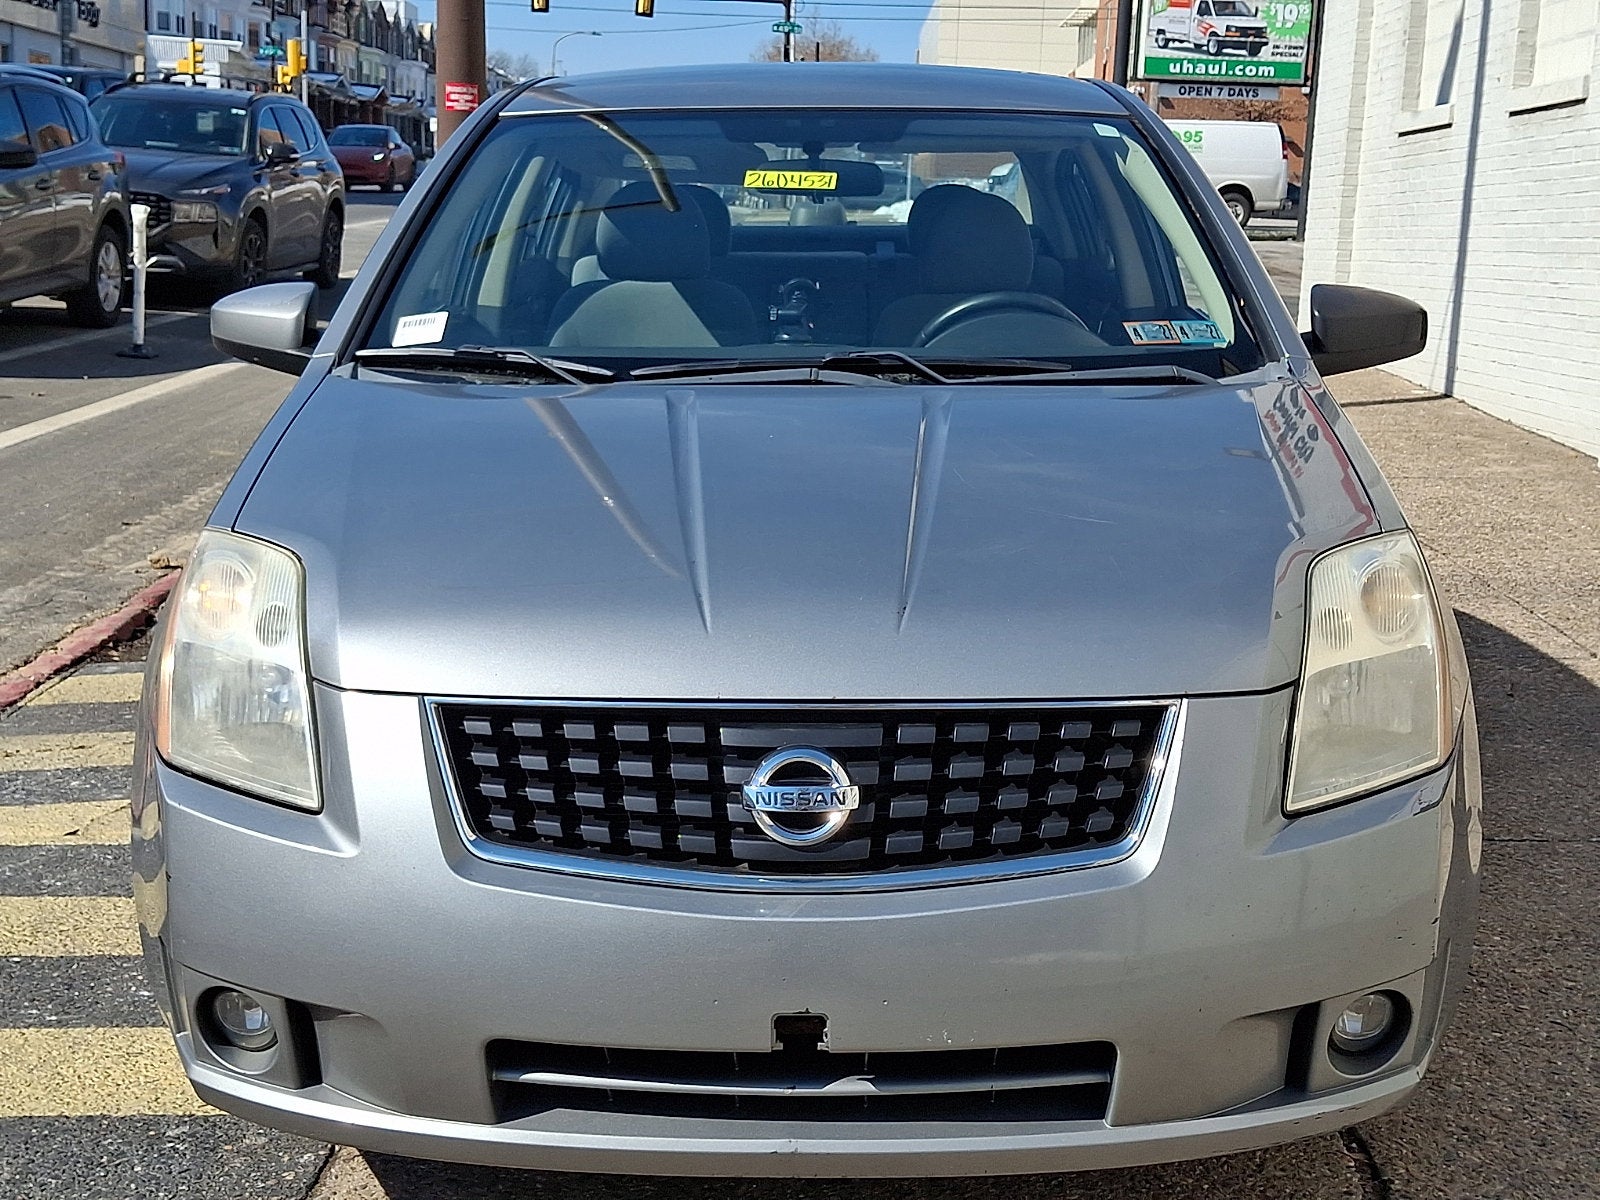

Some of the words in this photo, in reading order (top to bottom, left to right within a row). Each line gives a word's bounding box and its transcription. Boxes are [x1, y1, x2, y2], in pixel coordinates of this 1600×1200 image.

[1168, 60, 1275, 77] uhaul.com
[1178, 85, 1213, 96] OPEN
[1217, 87, 1224, 96] 7
[1227, 87, 1260, 98] DAYS
[755, 791, 846, 806] NISSAN
